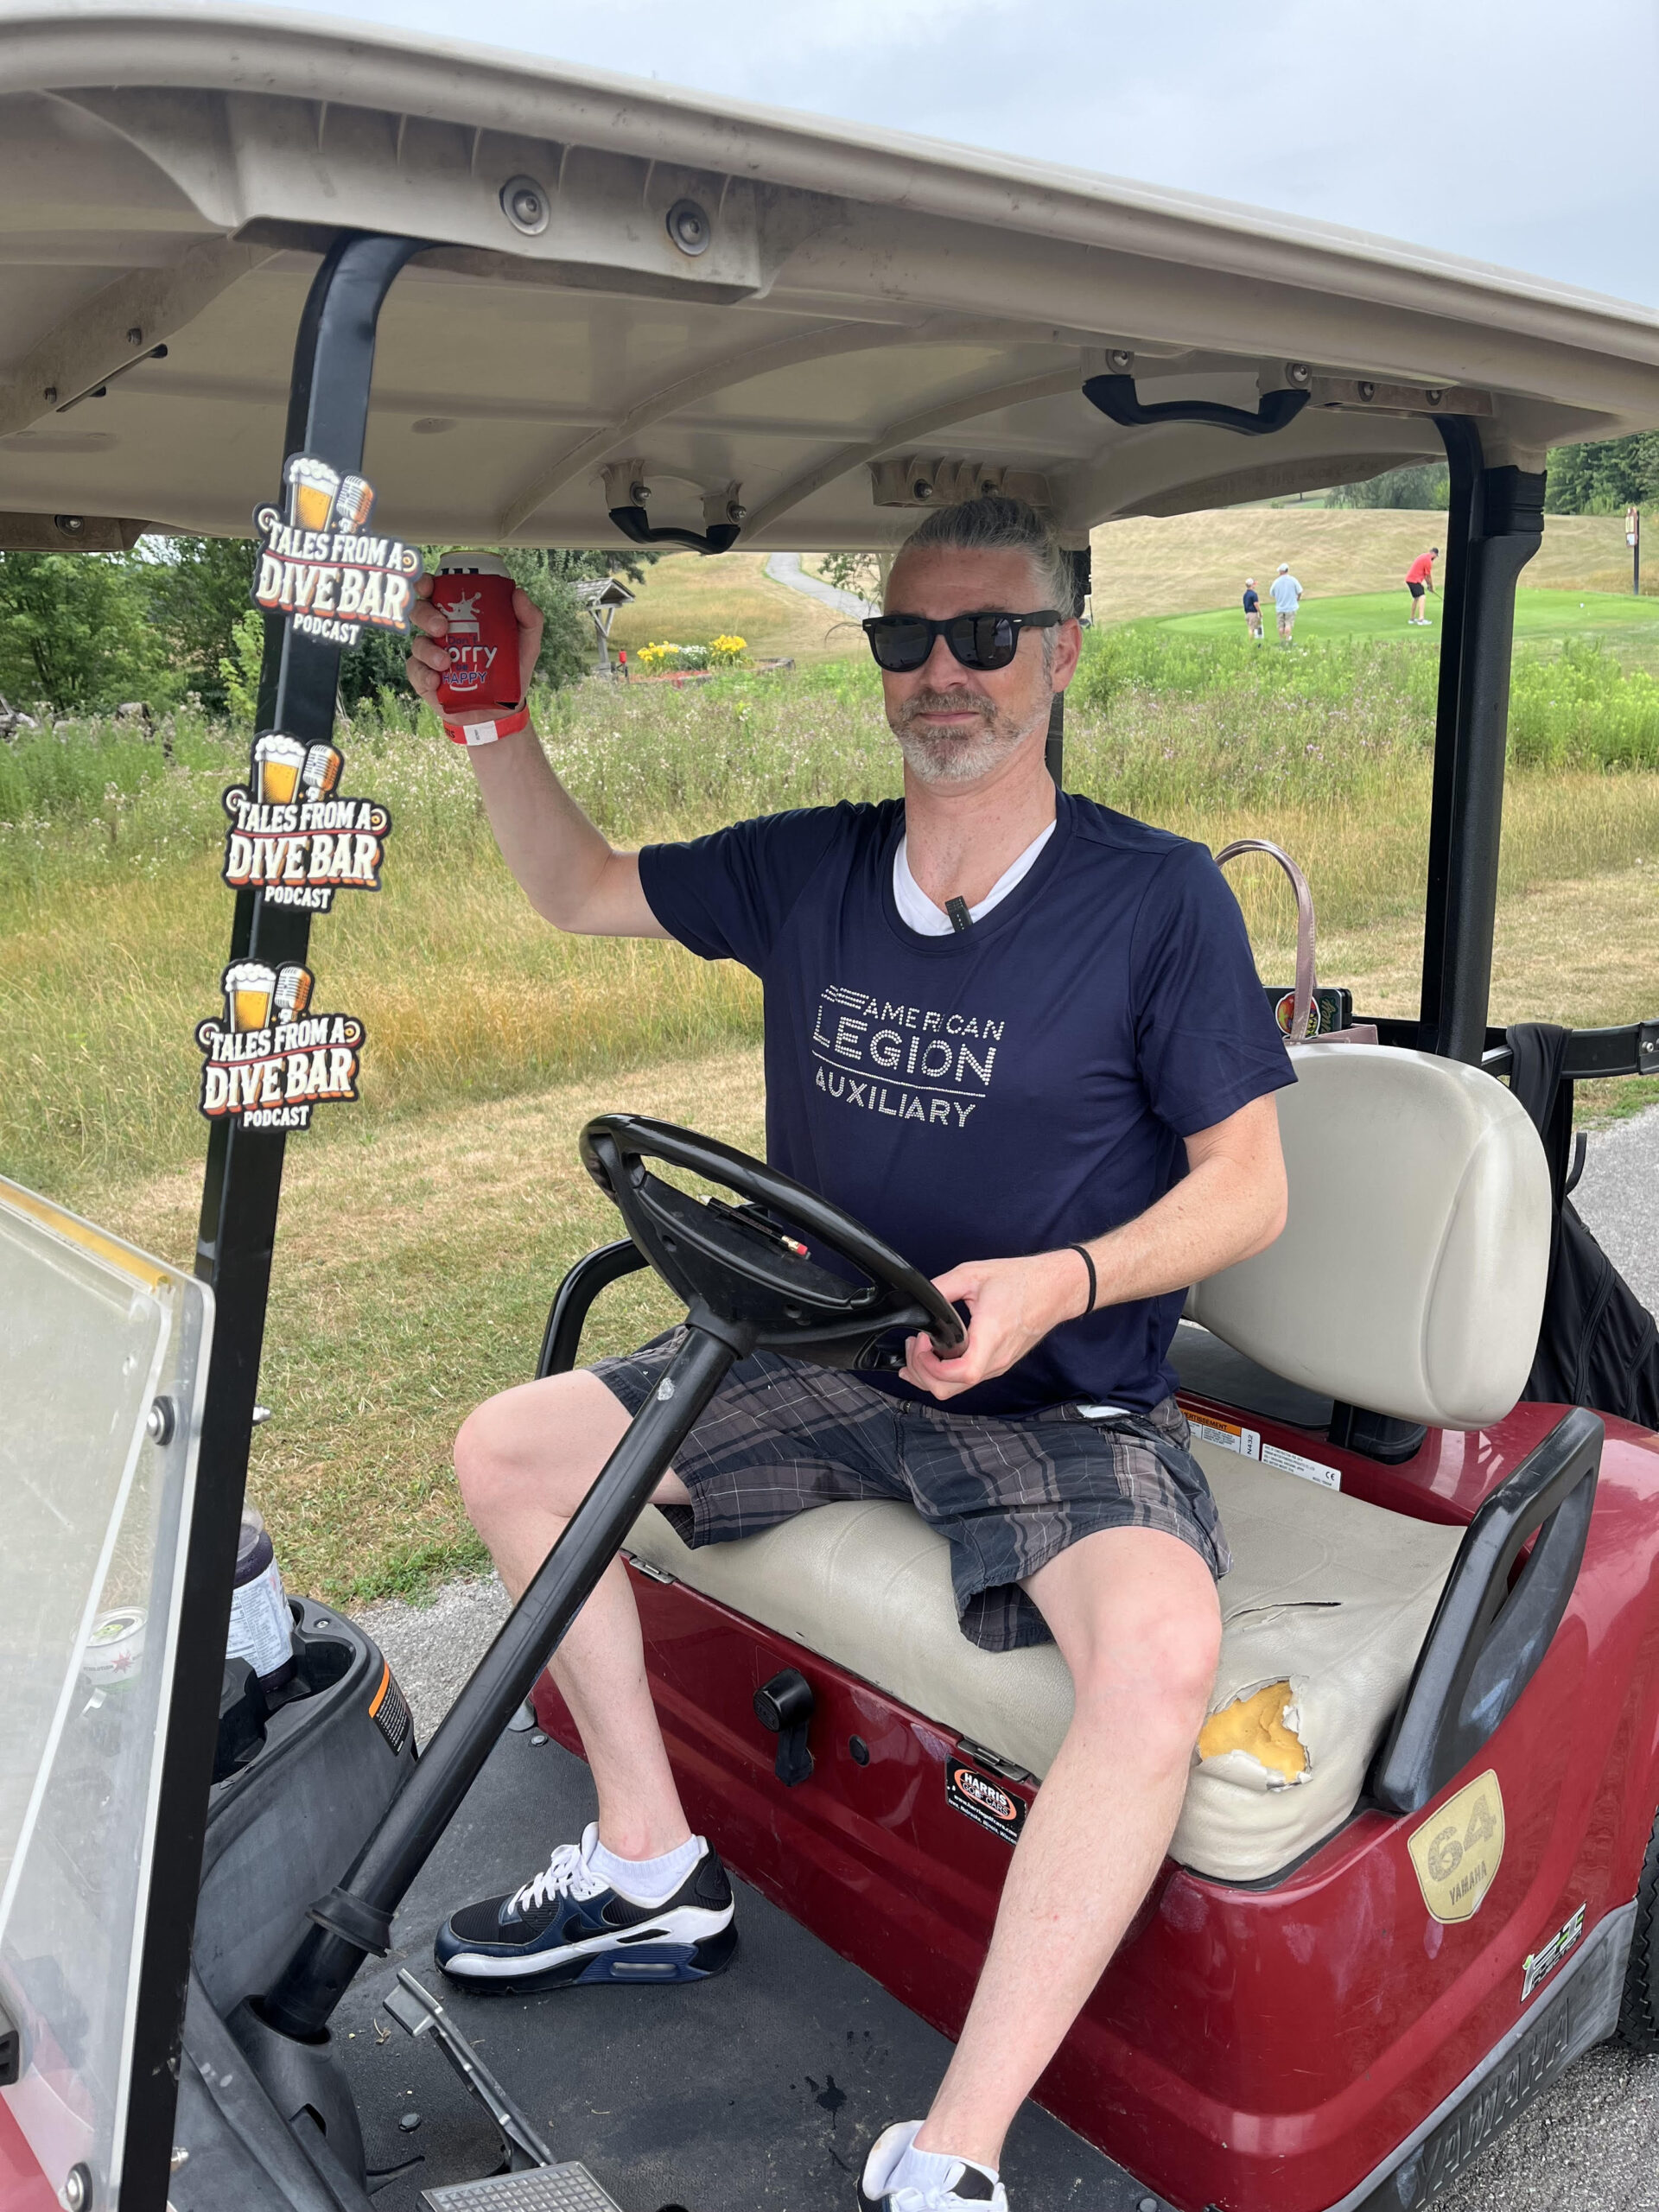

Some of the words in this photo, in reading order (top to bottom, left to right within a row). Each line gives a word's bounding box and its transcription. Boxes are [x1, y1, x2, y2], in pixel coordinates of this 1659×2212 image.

[268, 518, 331, 562] TALES
[330, 534, 390, 568] FROM
[387, 543, 405, 572] A
[256, 553, 340, 617] DIVE
[336, 569, 410, 626] BAR
[293, 613, 360, 646] PODCAST
[442, 671, 488, 685] HAPPY
[444, 645, 499, 669] orry
[236, 798, 300, 833] TALES
[298, 800, 358, 831] FROM
[356, 803, 373, 831] A
[225, 833, 308, 884] DIVE
[307, 833, 379, 882] BAR
[264, 886, 333, 910] PODCAST
[210, 1028, 272, 1063] TALES
[274, 1018, 330, 1054] FROM
[329, 1016, 348, 1046] A
[862, 997, 1006, 1042] AMERICAN
[812, 1004, 998, 1086] LEGION
[203, 1058, 284, 1111] DIVE
[283, 1047, 355, 1102] BAR
[815, 1065, 976, 1128] AUXILIARY
[243, 1105, 310, 1128] PODCAST
[1183, 1412, 1228, 1431] VERTISSEMENT
[963, 1772, 1007, 1806] HARRIS
[963, 1783, 984, 1799] GOLF
[985, 1796, 1008, 1816] CARS
[1427, 1794, 1497, 1883] 64
[1449, 1860, 1488, 1906] YAMAHA
[1414, 1997, 1570, 2209] YAMAHA
